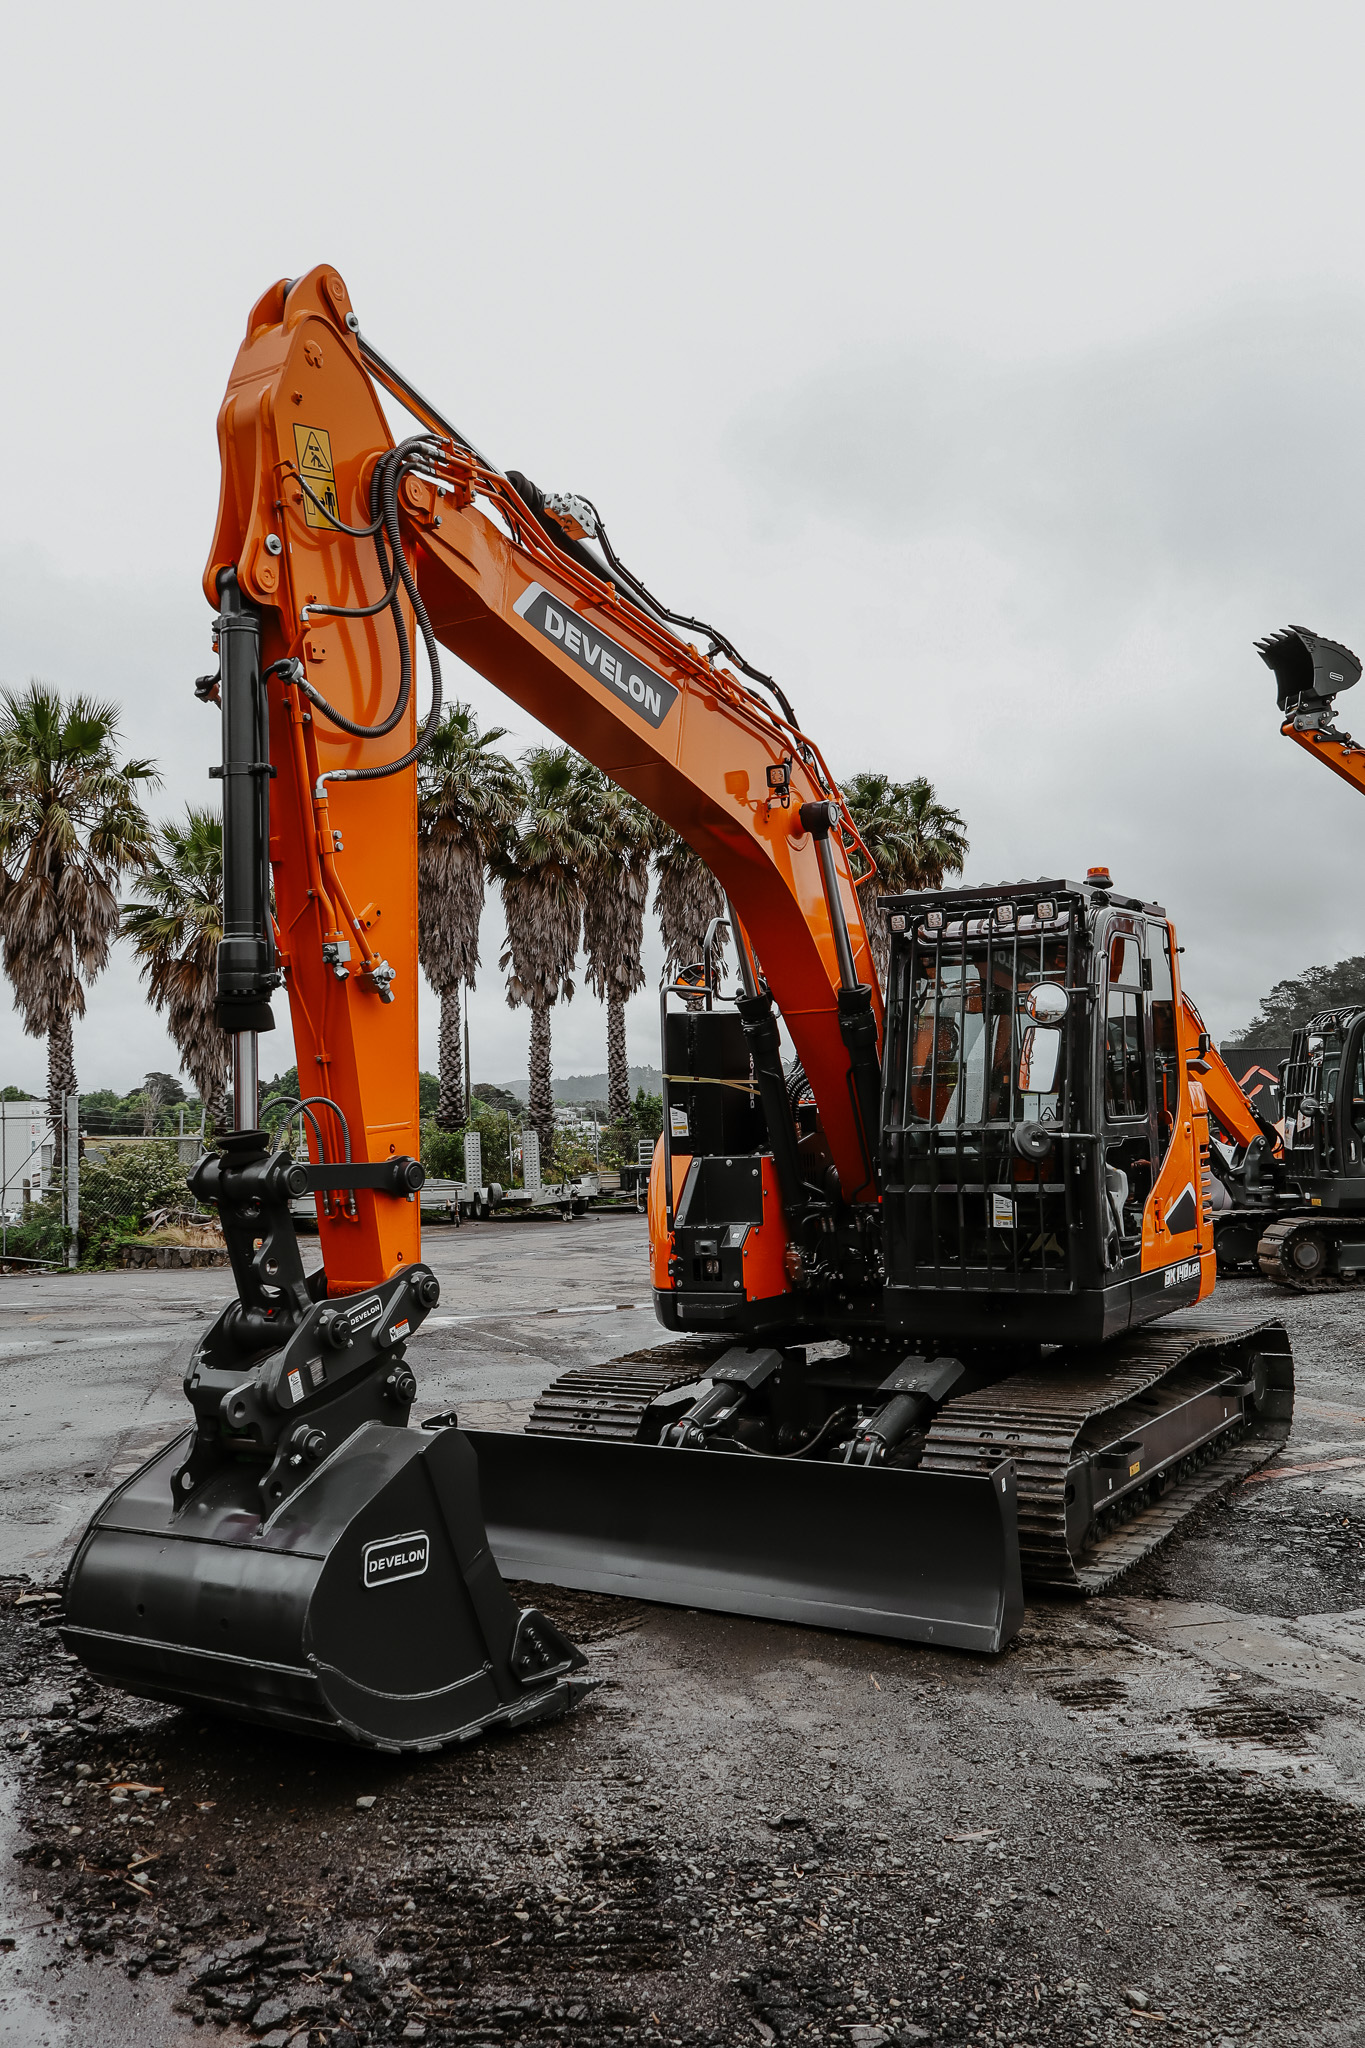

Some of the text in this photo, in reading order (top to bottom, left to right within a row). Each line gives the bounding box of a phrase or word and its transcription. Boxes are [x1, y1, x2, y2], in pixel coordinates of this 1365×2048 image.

[544, 604, 662, 717] DEVELON
[350, 1304, 380, 1326] DEVELON
[368, 1548, 426, 1573] DEVELON
